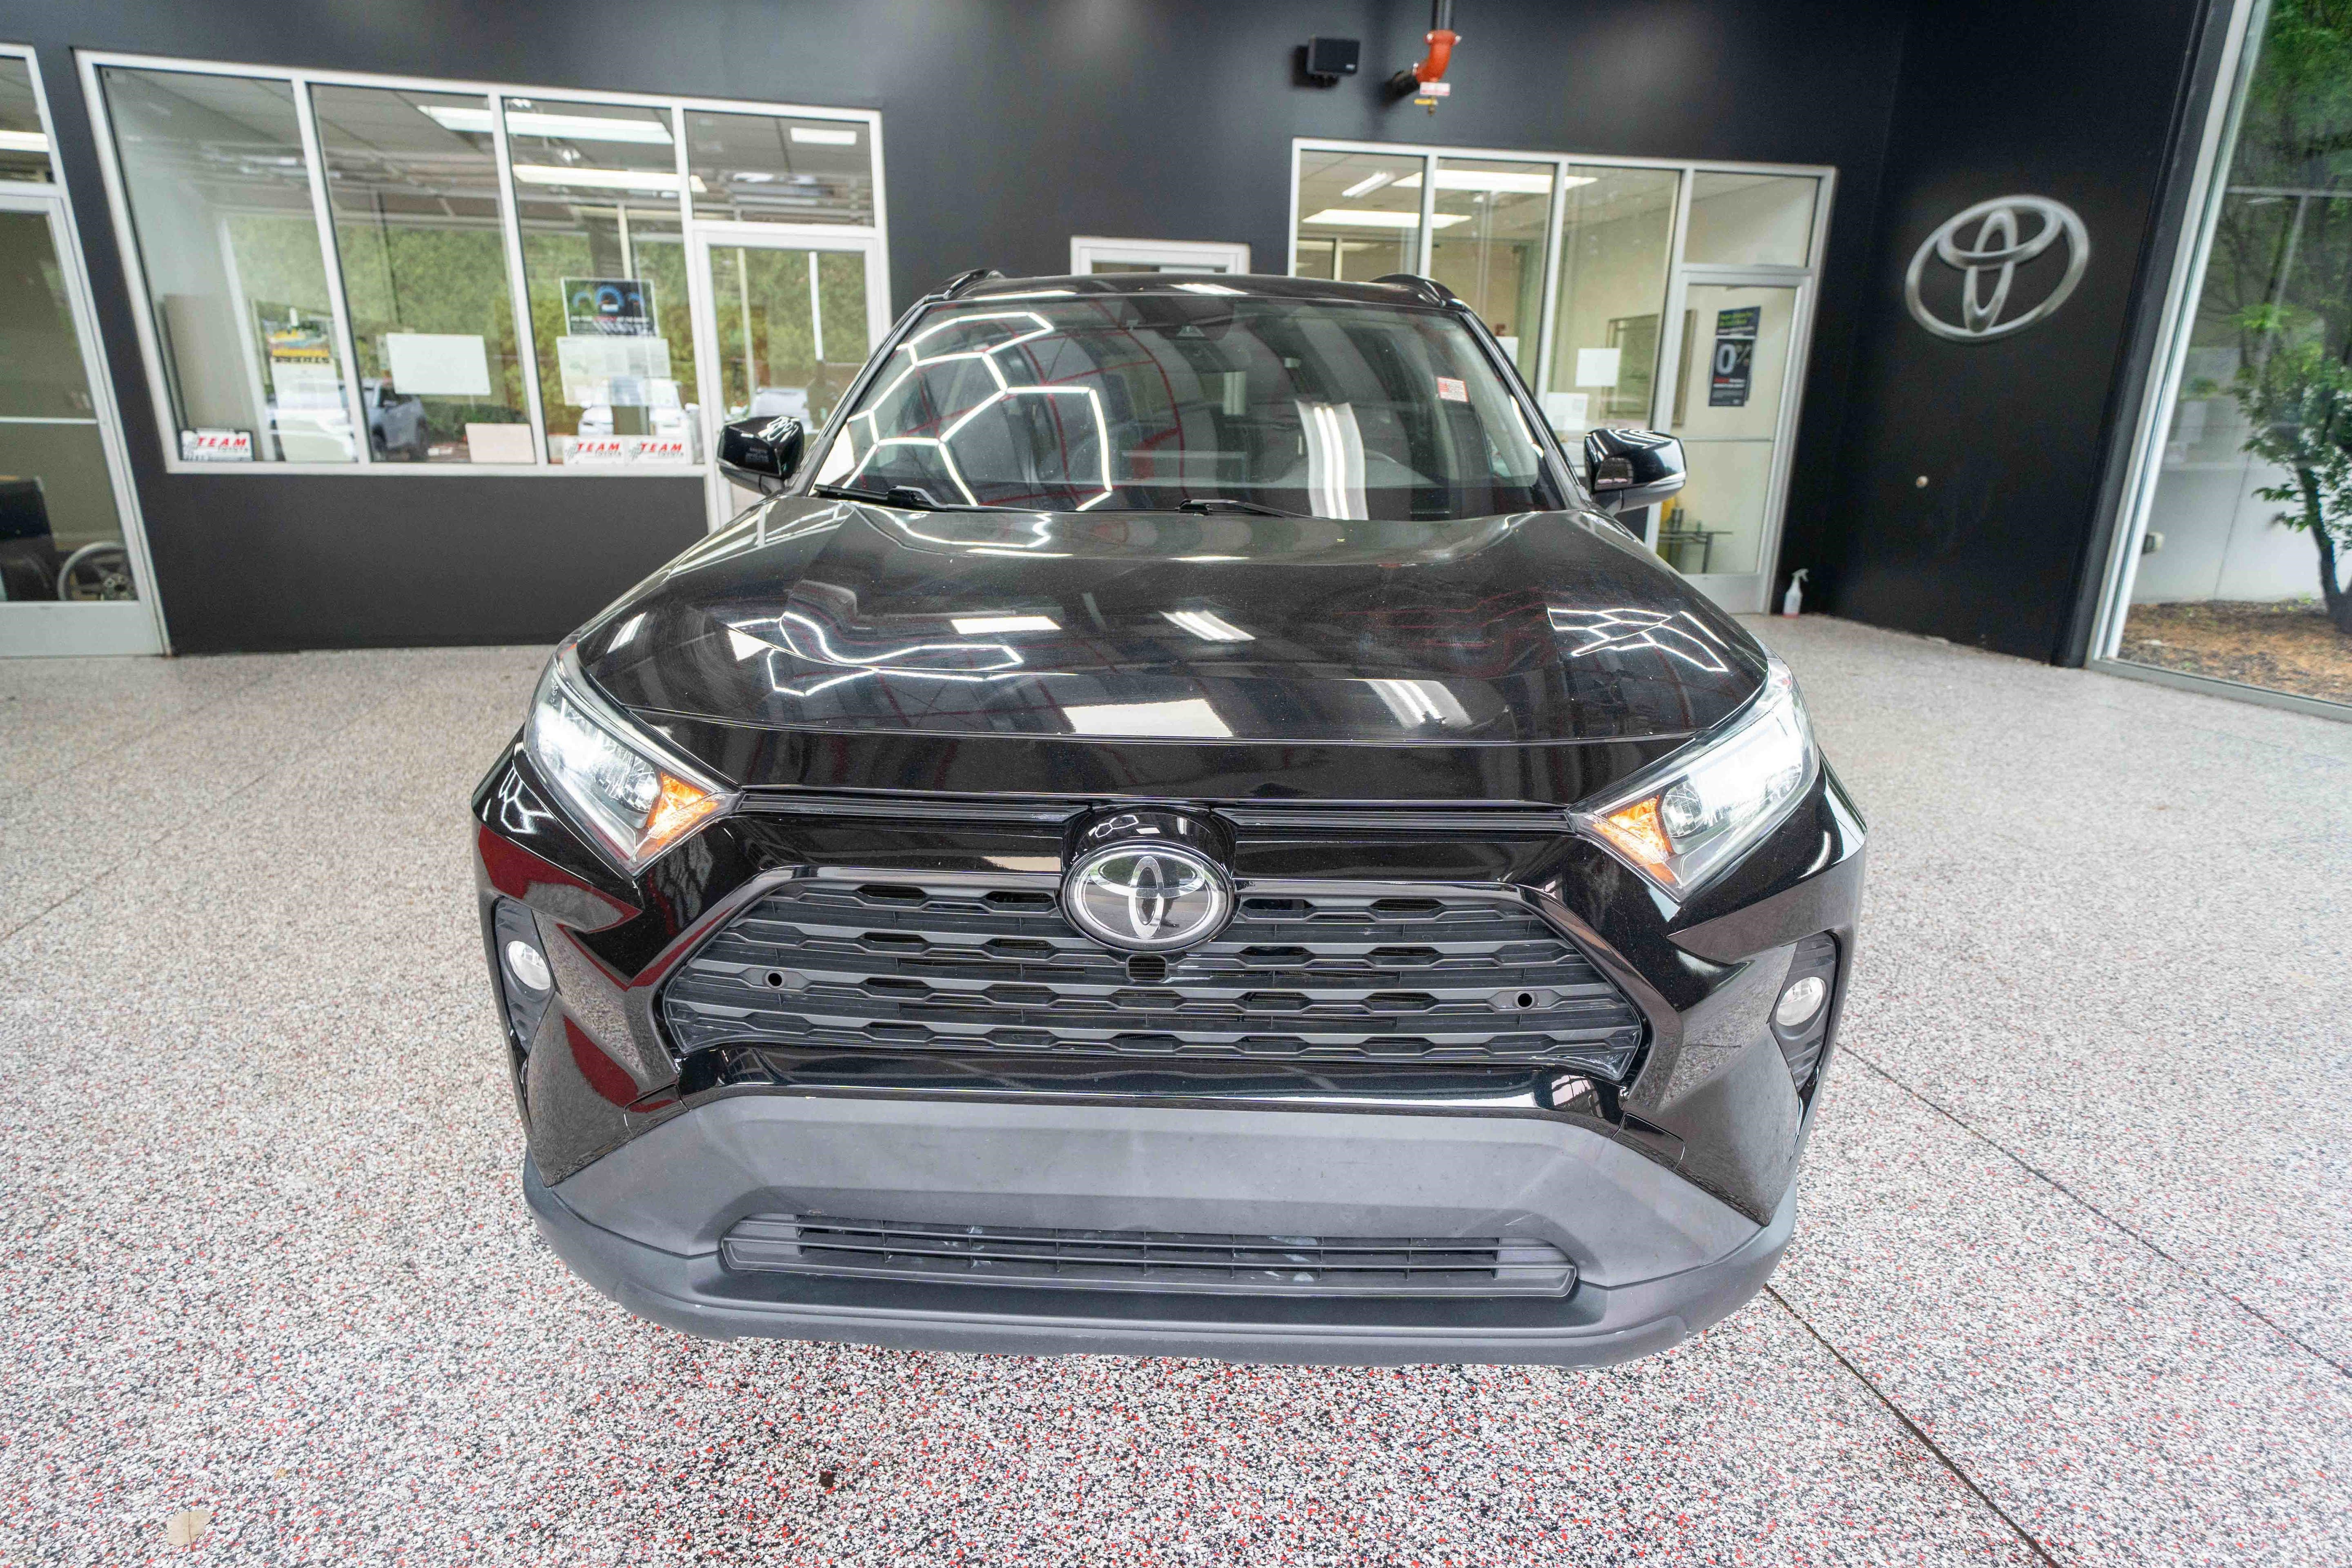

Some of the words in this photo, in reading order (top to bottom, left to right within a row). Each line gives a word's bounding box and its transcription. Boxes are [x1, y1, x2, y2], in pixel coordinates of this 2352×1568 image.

[197, 437, 247, 447] TEAM
[577, 443, 620, 452] TEAM
[641, 443, 682, 452] TEAM
